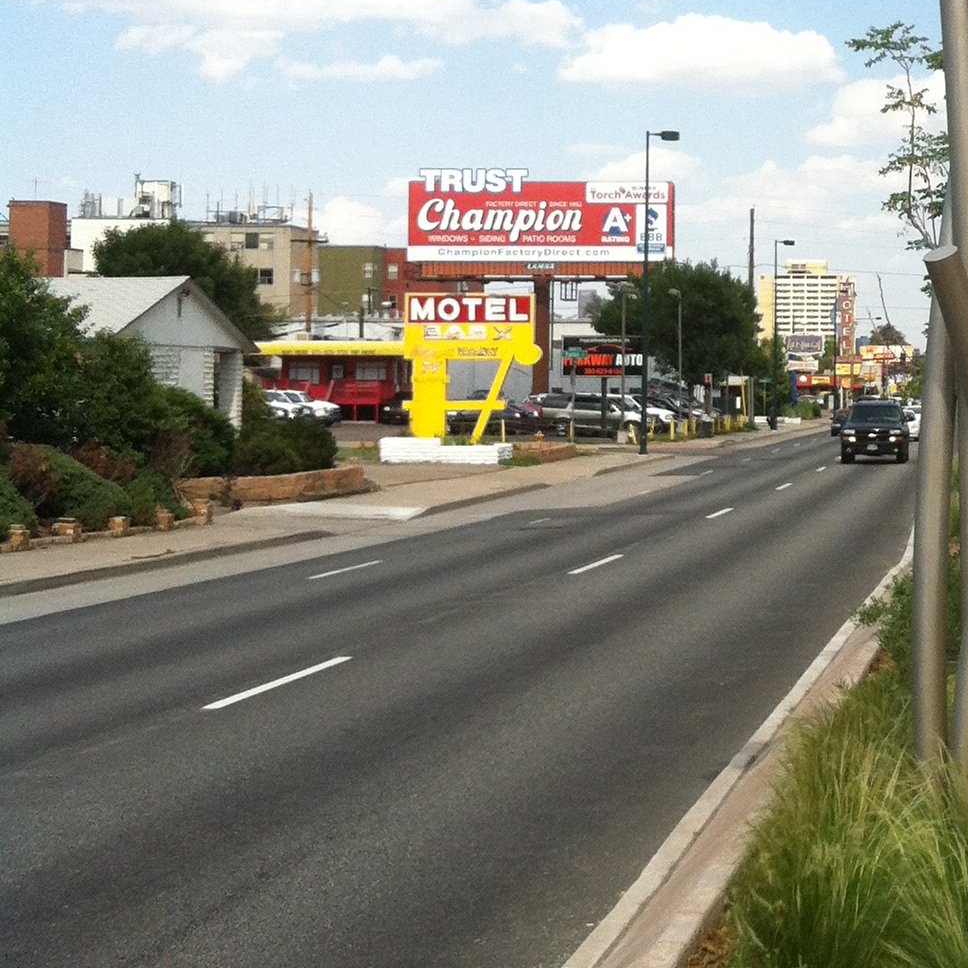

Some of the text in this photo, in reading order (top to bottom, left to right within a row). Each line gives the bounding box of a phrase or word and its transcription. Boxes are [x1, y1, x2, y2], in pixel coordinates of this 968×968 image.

[419, 168, 529, 194] TRUST
[590, 190, 666, 200] Torch Awards
[417, 198, 583, 243] Champion
[428, 235, 577, 243] WINDOWS SIDING PATIO ROOMS
[601, 236, 631, 244] RATING
[438, 248, 610, 257] ChampionFactoryDirect.com
[410, 297, 529, 322] MOTEL
[615, 353, 643, 367] AUTO
